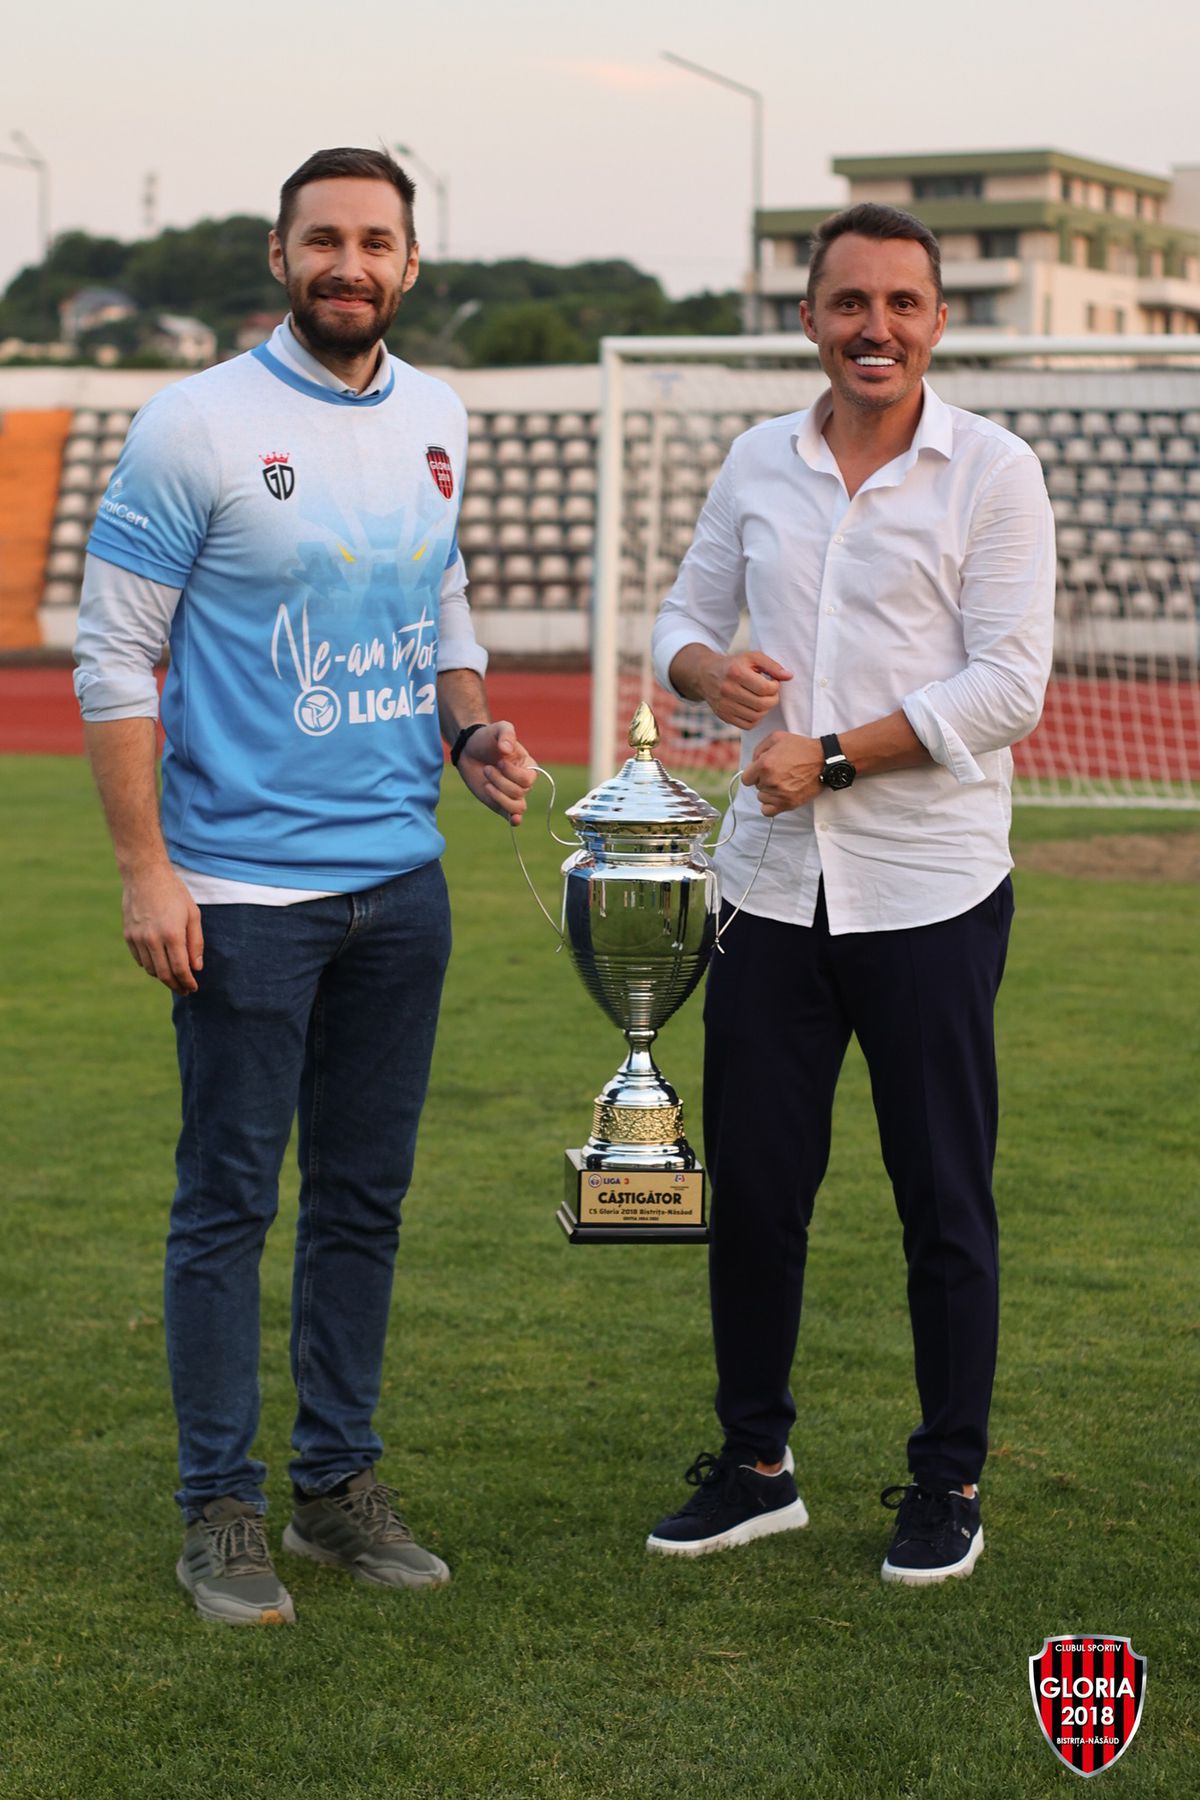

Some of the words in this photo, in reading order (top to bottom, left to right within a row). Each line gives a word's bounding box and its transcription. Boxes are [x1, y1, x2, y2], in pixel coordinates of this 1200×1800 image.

[271, 598, 385, 691] Ne-am
[603, 1177, 621, 1185] LIGA
[599, 1208, 619, 1216] Gloria
[620, 1208, 638, 1216] 2018
